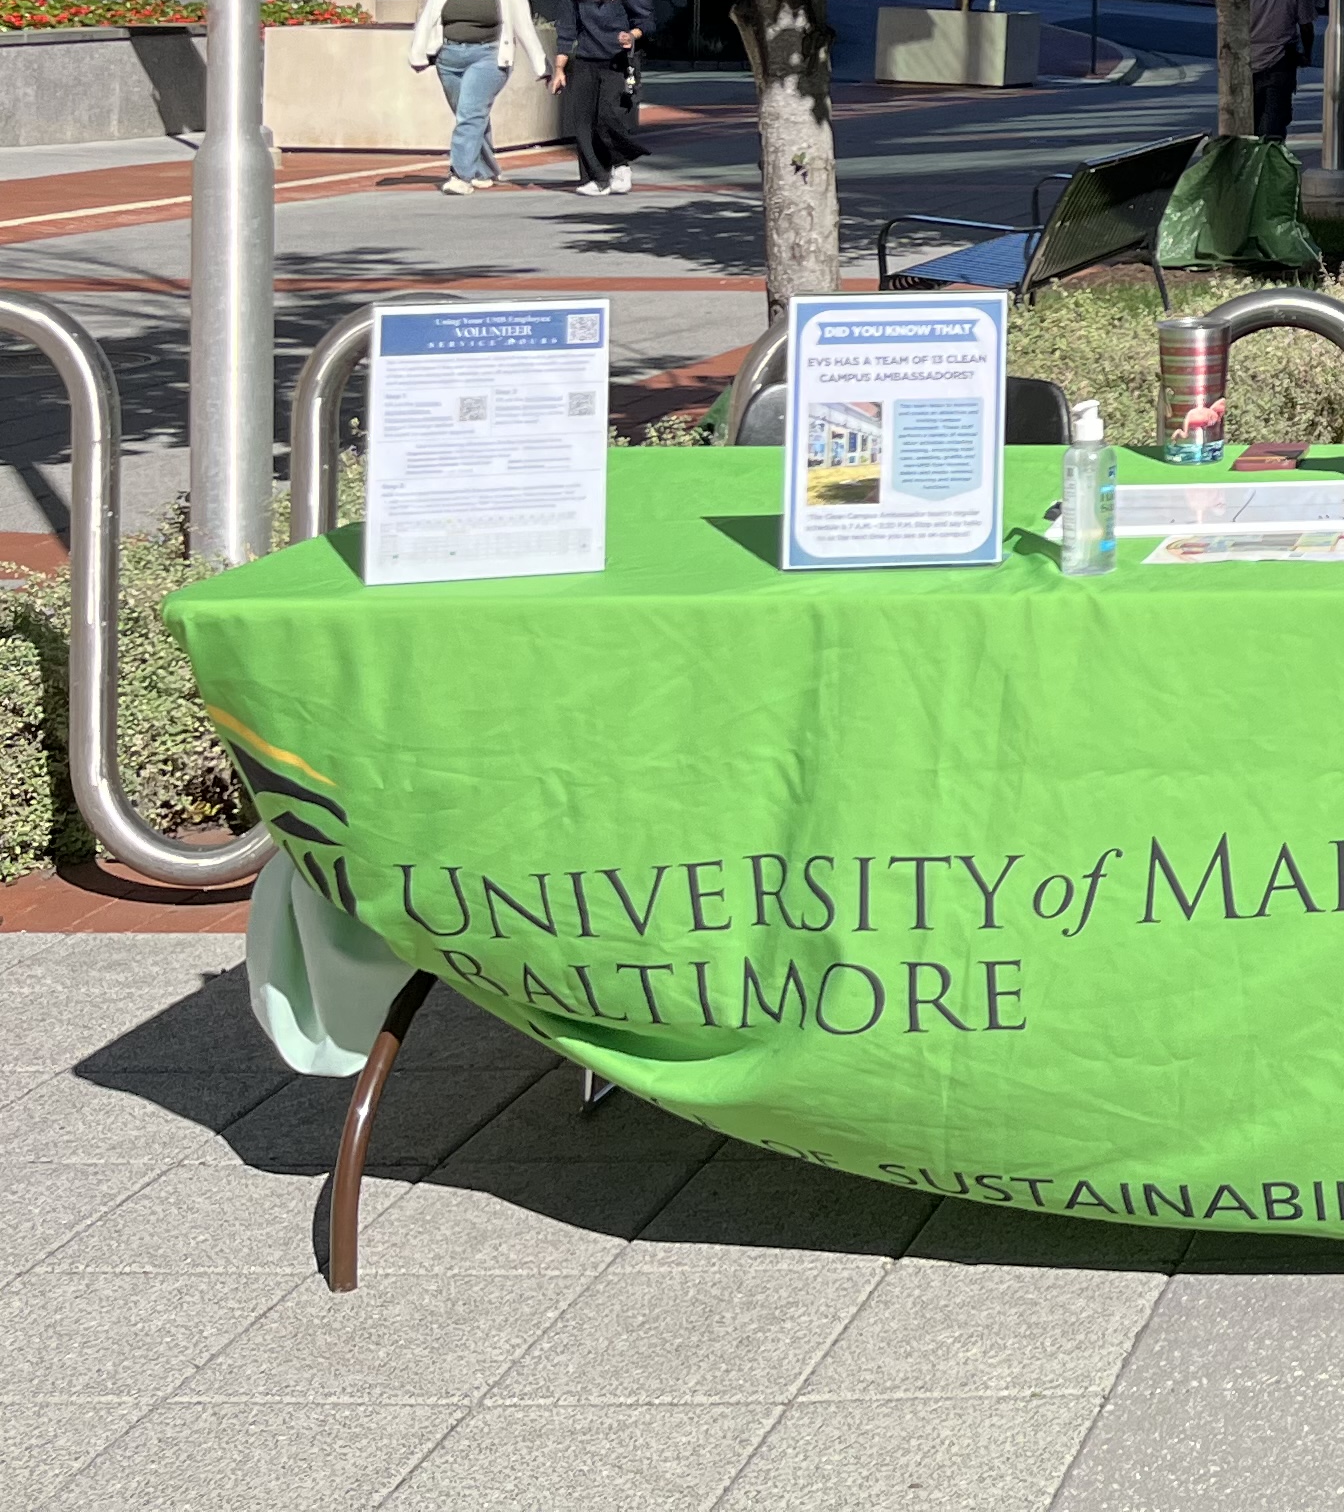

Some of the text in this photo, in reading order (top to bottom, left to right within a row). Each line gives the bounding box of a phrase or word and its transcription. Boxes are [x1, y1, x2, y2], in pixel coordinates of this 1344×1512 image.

[455, 325, 532, 338] VOLUNTEER
[824, 323, 973, 338] DID YOU KNOW THAT
[807, 357, 831, 367] EVS
[834, 356, 860, 366] HAS
[863, 356, 873, 365] A
[875, 355, 910, 365] TEAM
[912, 355, 929, 365] OF
[946, 354, 987, 364] CLEAN
[819, 371, 975, 383] CAMPUS AMBASSADORS?
[393, 852, 1025, 938] UNIVERSITY
[1032, 848, 1123, 937] of
[436, 947, 1027, 1035] BALTIMORE
